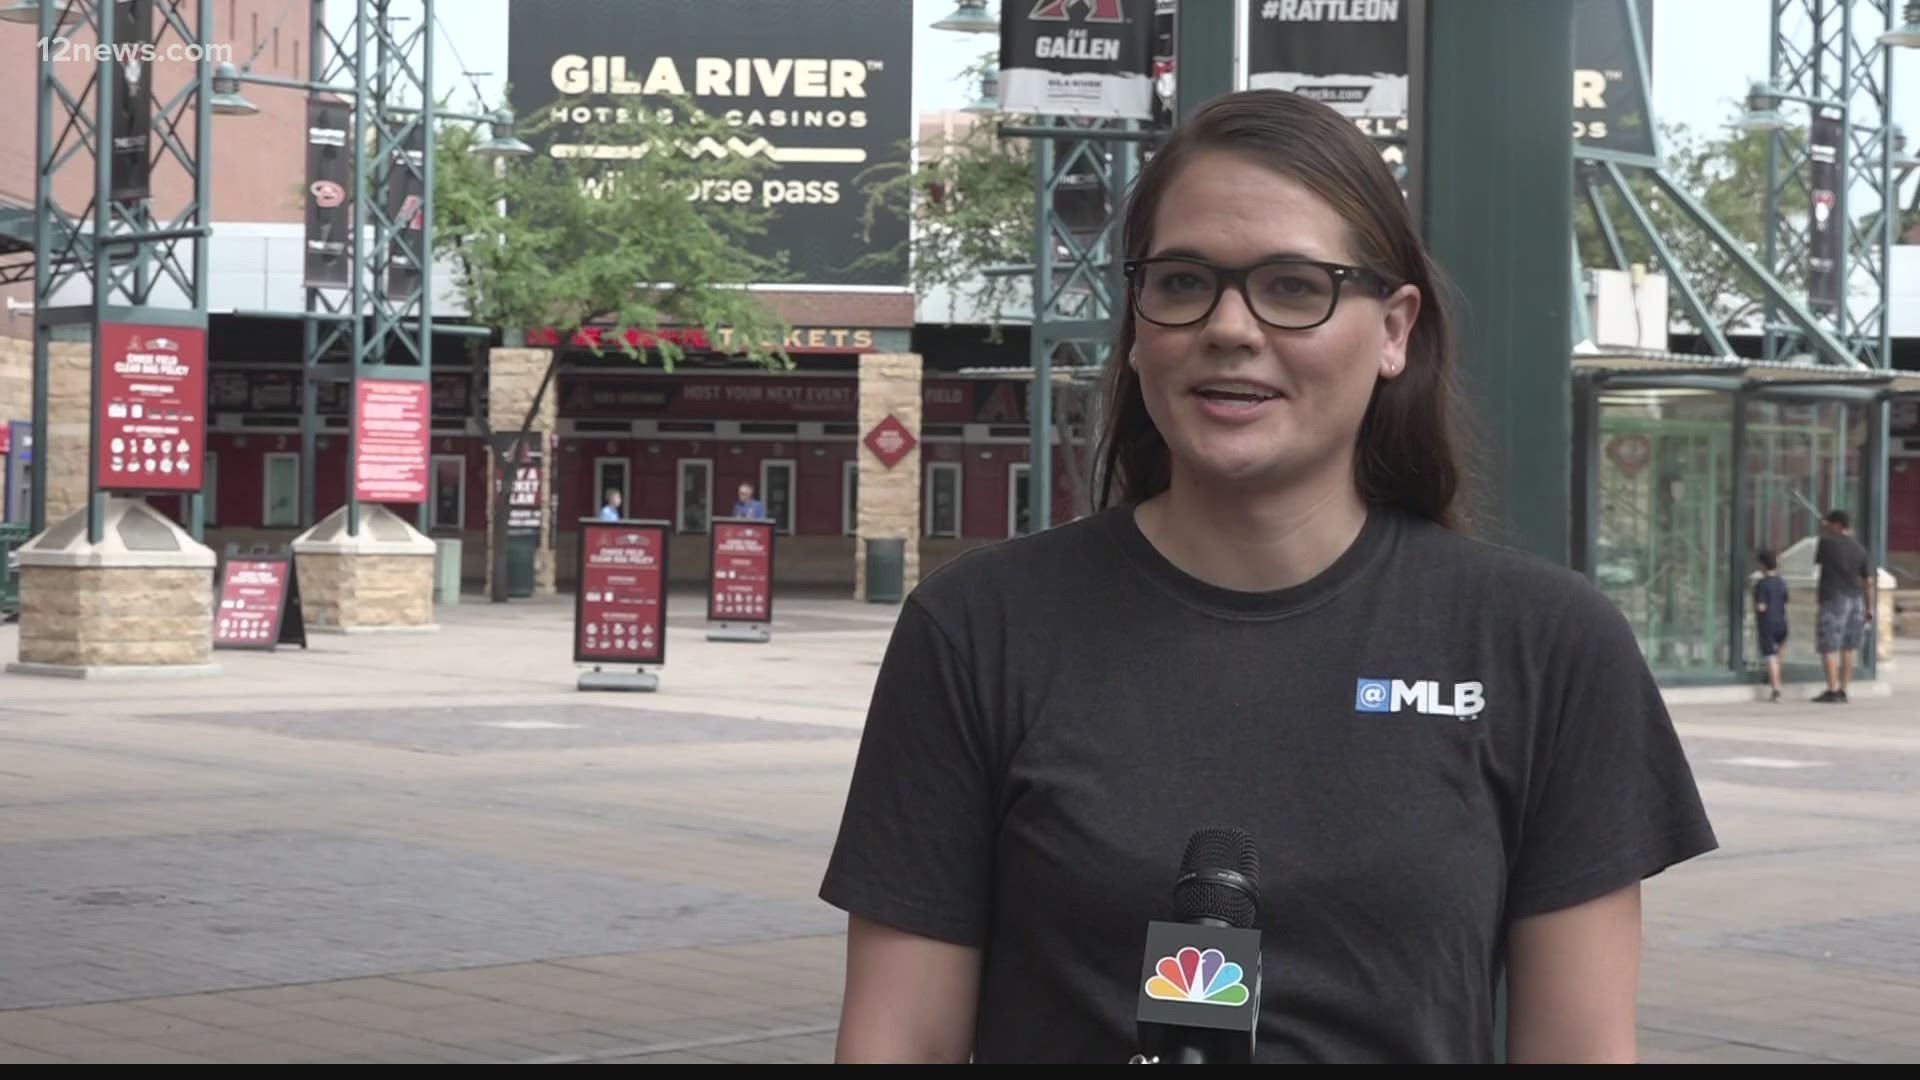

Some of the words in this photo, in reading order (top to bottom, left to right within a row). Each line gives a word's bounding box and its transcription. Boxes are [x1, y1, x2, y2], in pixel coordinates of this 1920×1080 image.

[1261, 0, 1399, 21] #RATTLEON
[1035, 36, 1120, 60] GALLEN
[551, 54, 686, 95] GILA
[550, 107, 674, 124] HOTELS
[725, 109, 867, 127] CASINOS
[763, 179, 840, 207] pass
[684, 386, 722, 400] HOST
[725, 386, 763, 400] YOUR
[766, 387, 803, 400] NEXT
[806, 388, 850, 401] EVENT
[1356, 678, 1486, 716] @MLB
